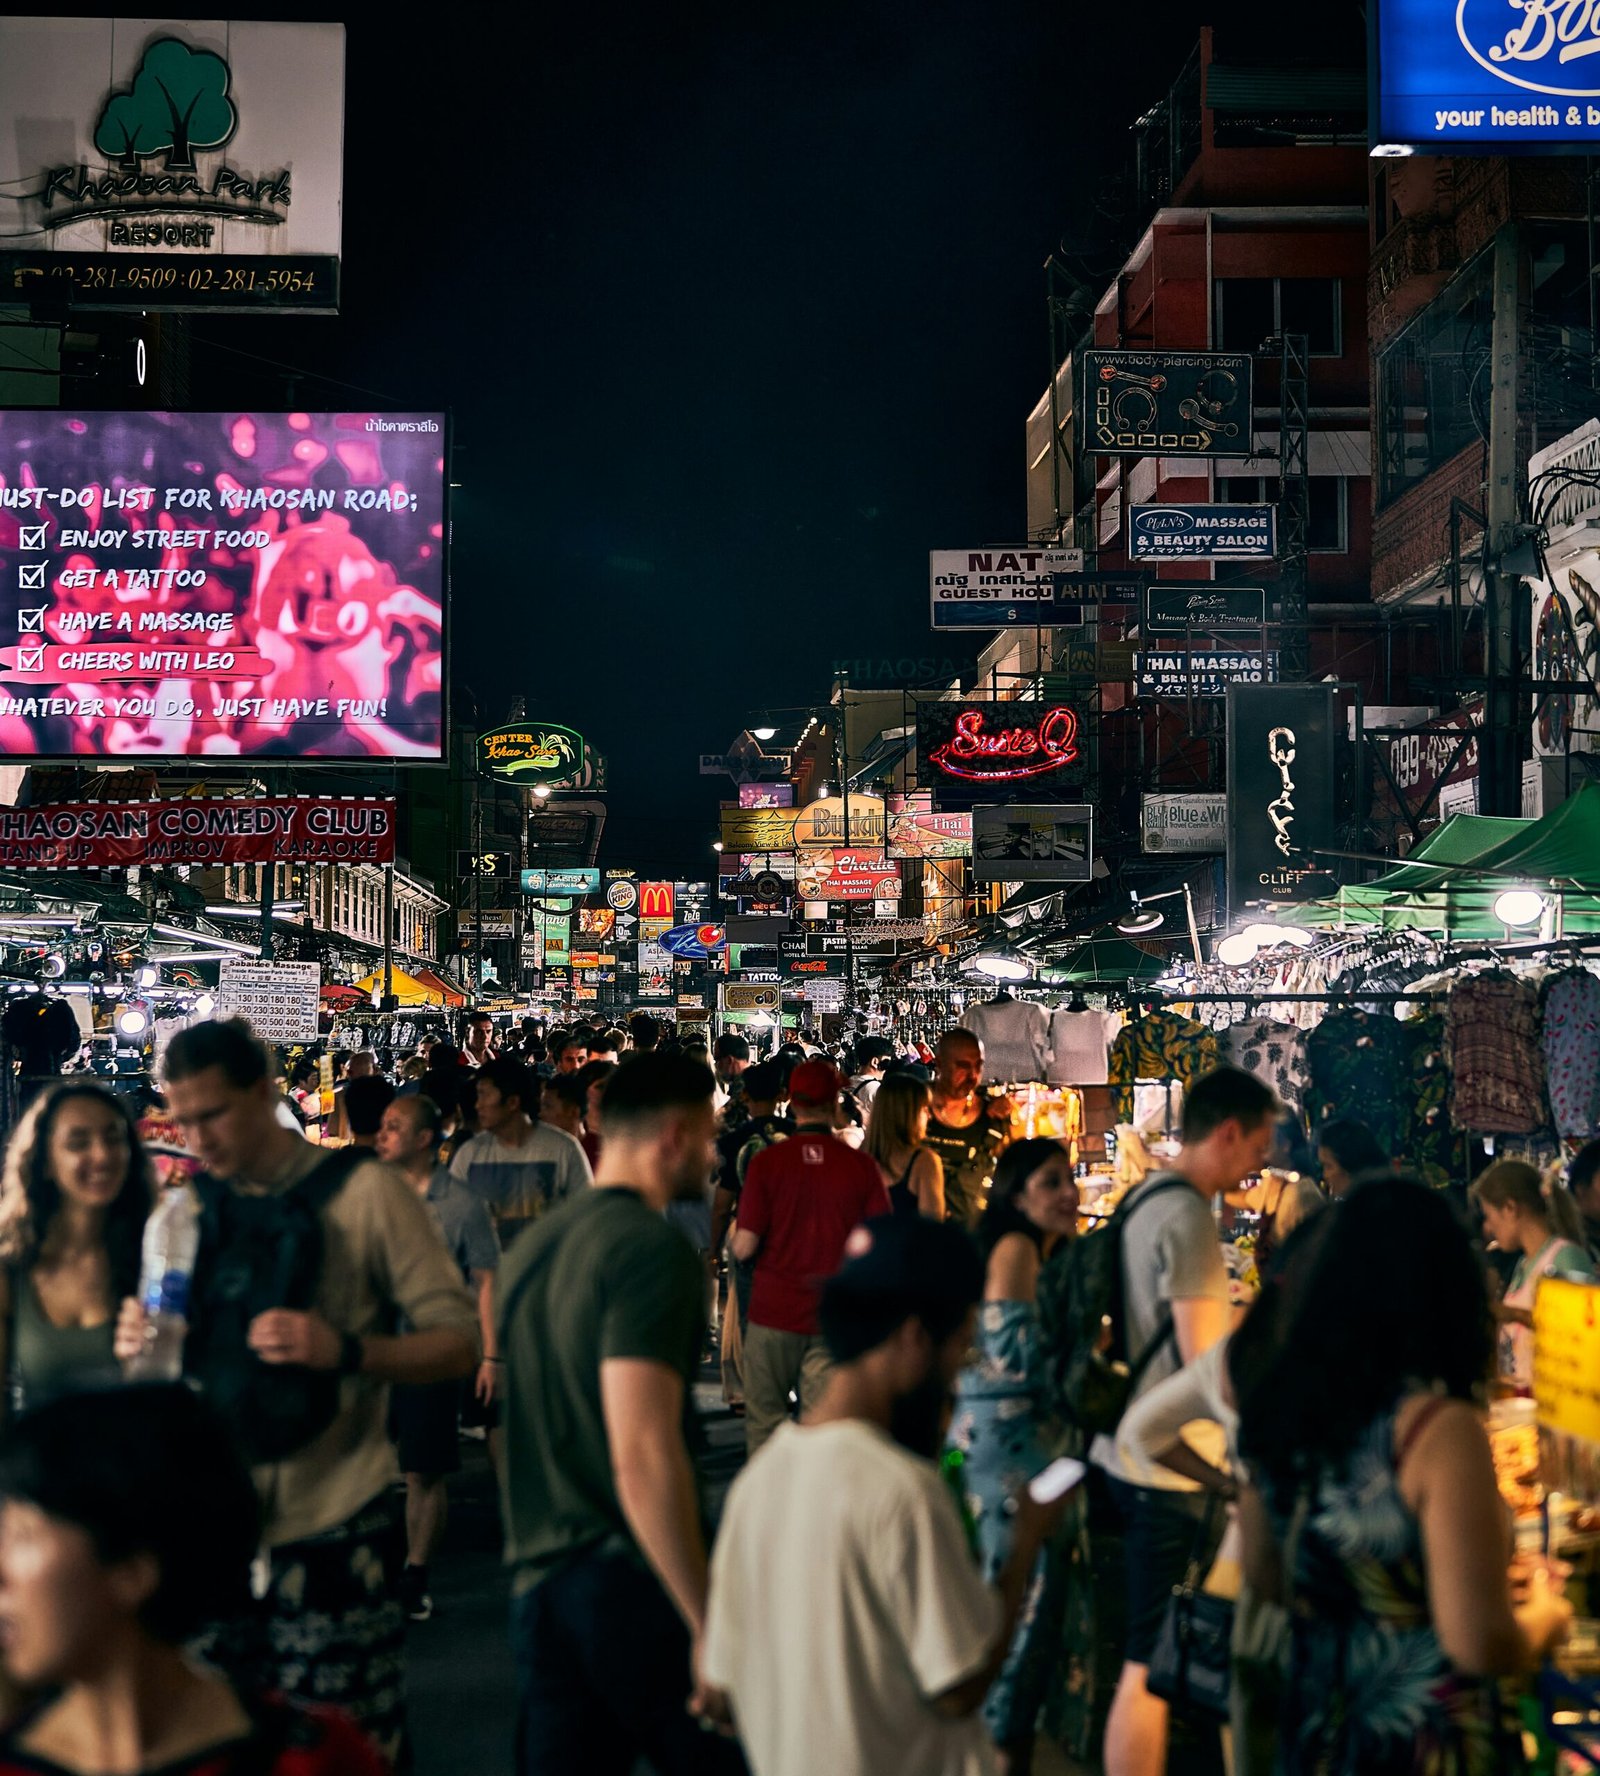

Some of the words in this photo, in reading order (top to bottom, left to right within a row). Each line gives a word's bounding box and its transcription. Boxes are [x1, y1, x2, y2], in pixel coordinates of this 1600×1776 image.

[1435, 110, 1484, 130] your
[1491, 106, 1559, 126] health
[1565, 106, 1581, 125] &
[46, 165, 201, 207] Khaosan
[213, 168, 291, 206] Park
[111, 223, 214, 247] RESORT
[1094, 353, 1243, 369] www.body-piercing.com
[0, 487, 95, 510] UST-DO
[103, 488, 155, 509] LIST
[165, 489, 213, 510] FOR
[219, 489, 337, 510] KHAOSAN
[1195, 518, 1267, 528] MASSAGE
[59, 529, 128, 549] ENJOY
[132, 530, 210, 549] STREET
[214, 530, 270, 549] FOOD
[1137, 536, 1149, 546] &
[1154, 535, 1212, 546] BEAUTY
[1216, 535, 1268, 546] SALON
[968, 553, 1042, 572] NAT
[58, 569, 100, 588] GET
[103, 569, 119, 588] A
[126, 569, 207, 588] TATTOO
[939, 589, 1002, 598] GUEST
[1012, 588, 1052, 598] HOU
[58, 611, 112, 632] HAVE
[117, 612, 132, 631] A
[138, 612, 234, 632] MASSAGE
[57, 651, 133, 670] CHEERS
[139, 651, 189, 670] WITH
[194, 651, 235, 670] LEO
[114, 698, 154, 717] YOU
[164, 698, 202, 717] DO,
[213, 698, 267, 717] JUST
[272, 698, 330, 717] HAVE
[337, 698, 388, 718] FUN!
[484, 734, 533, 746] CENTER
[485, 744, 524, 759] Khao
[1170, 806, 1198, 822] Blue
[0, 810, 149, 840] HAOSAN
[159, 806, 297, 837] COMEDY
[307, 807, 389, 838] CLUB
[930, 818, 962, 830] Thai
[0, 843, 59, 862] TAND
[65, 842, 93, 862] UP
[144, 841, 226, 859] IMPROV
[273, 840, 378, 859] KARAOKE
[836, 856, 896, 874] Charlie
[1259, 873, 1304, 885] CLIFF
[611, 887, 631, 896] BURGER
[612, 892, 632, 903] KING
[782, 942, 806, 950] CHAR
[822, 938, 848, 947] TASTIN
[230, 960, 270, 968] Sabaidee
[273, 962, 312, 970] Massage
[254, 995, 268, 1003] 130
[253, 1006, 267, 1014] 230
[270, 1018, 284, 1026] 500
[269, 1029, 282, 1037] 600
